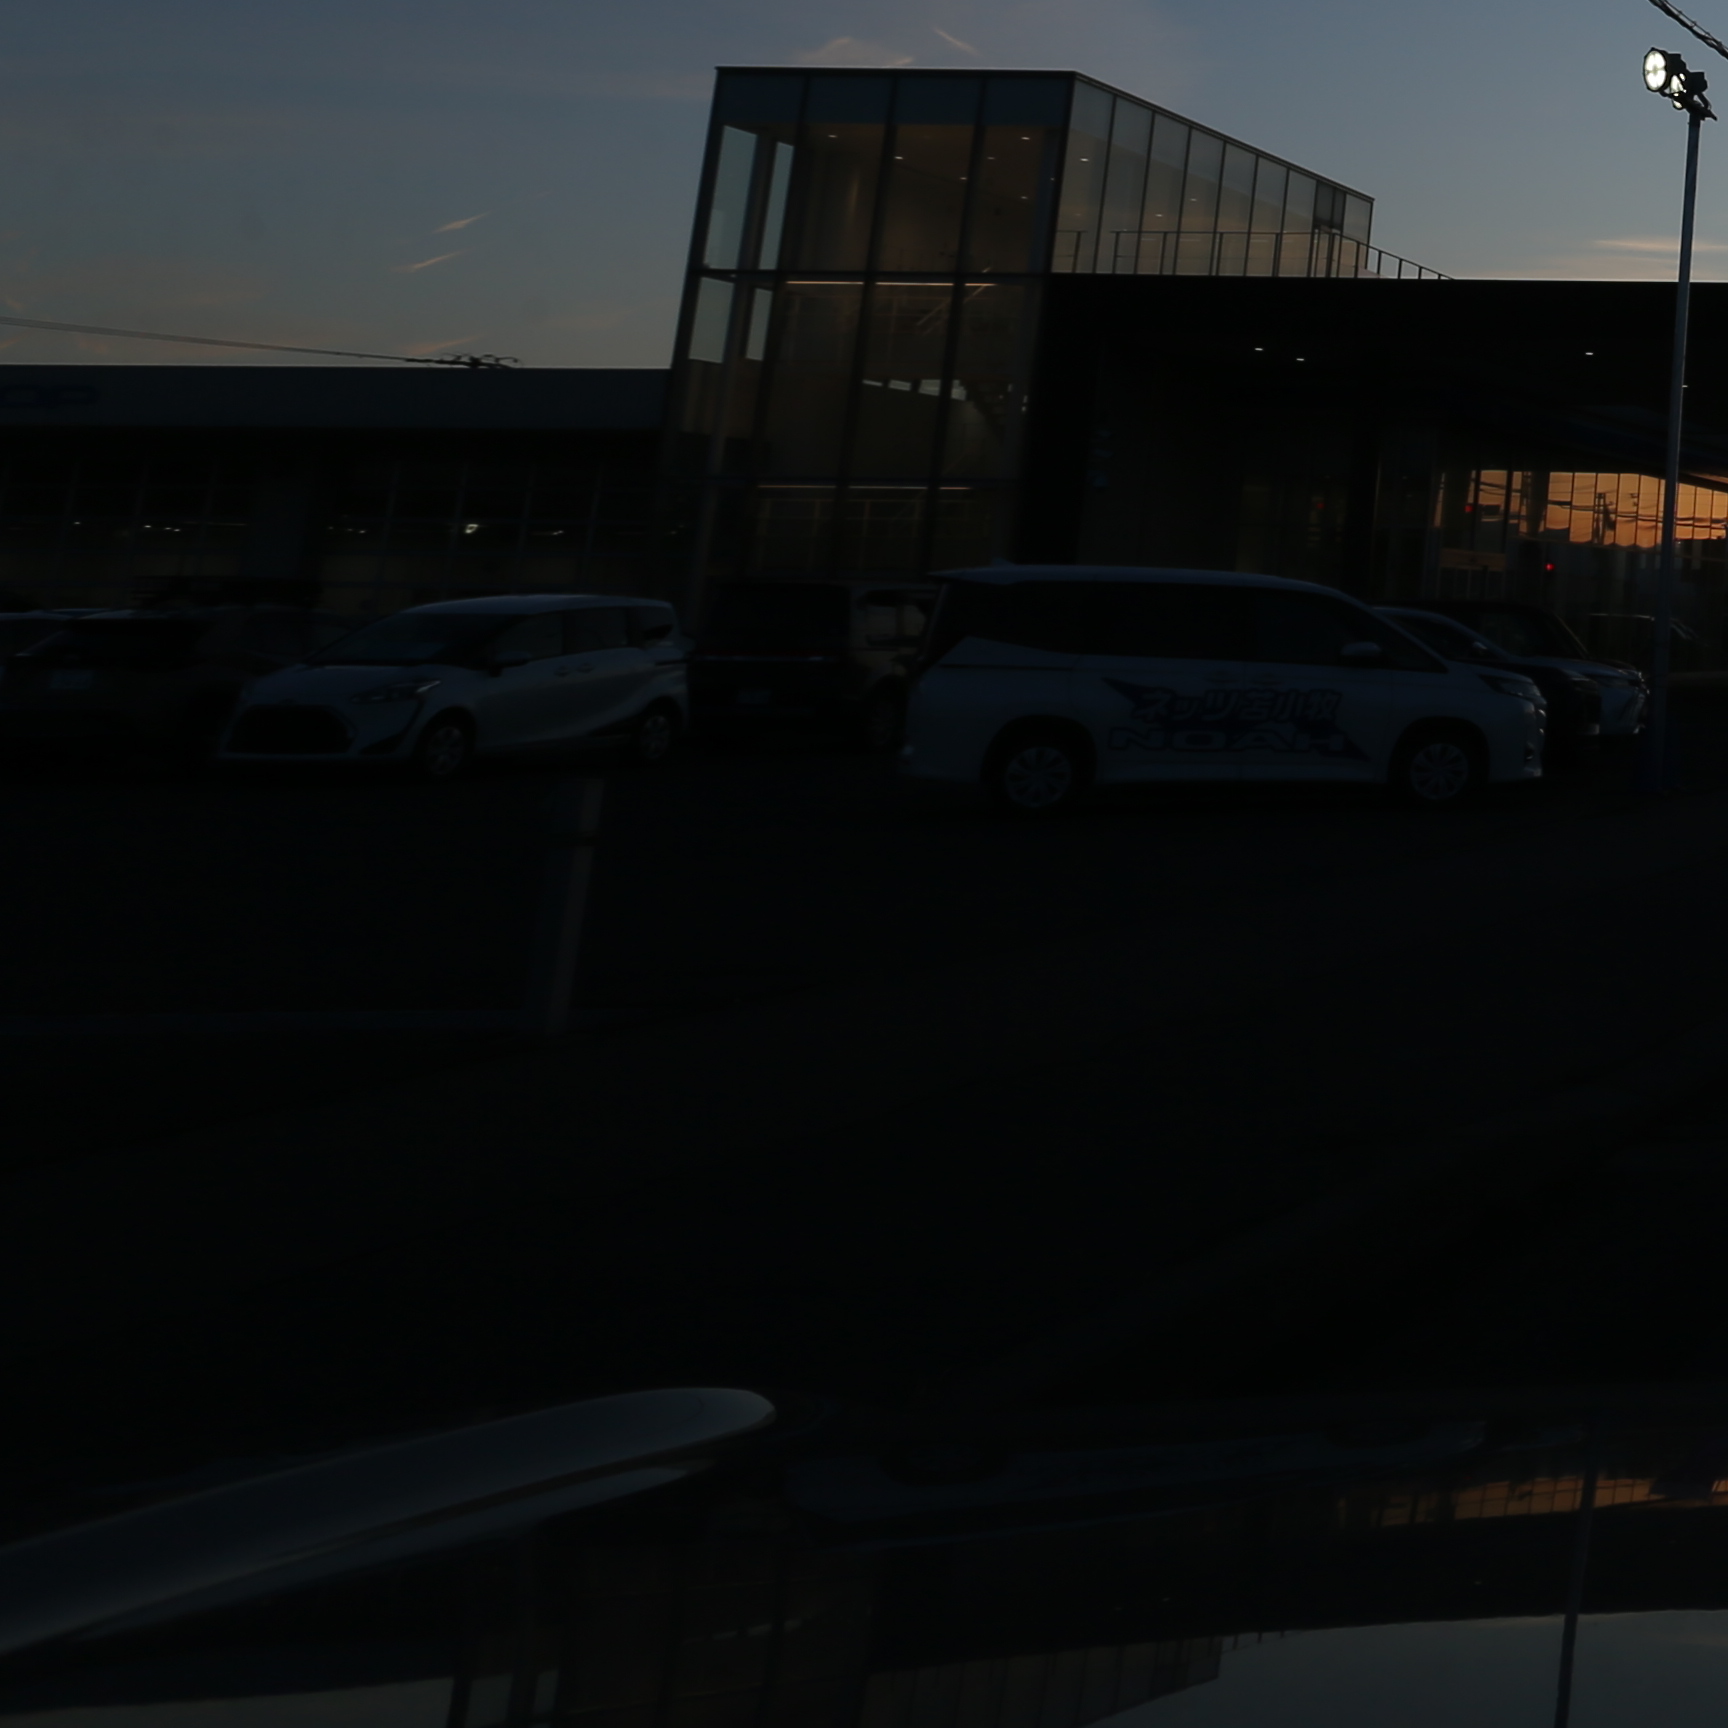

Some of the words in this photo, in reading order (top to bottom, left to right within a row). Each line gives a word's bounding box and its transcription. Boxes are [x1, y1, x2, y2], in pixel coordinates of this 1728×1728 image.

[1130, 688, 1343, 722] ネッツ苫小牧
[1108, 726, 1348, 753] NOAH
